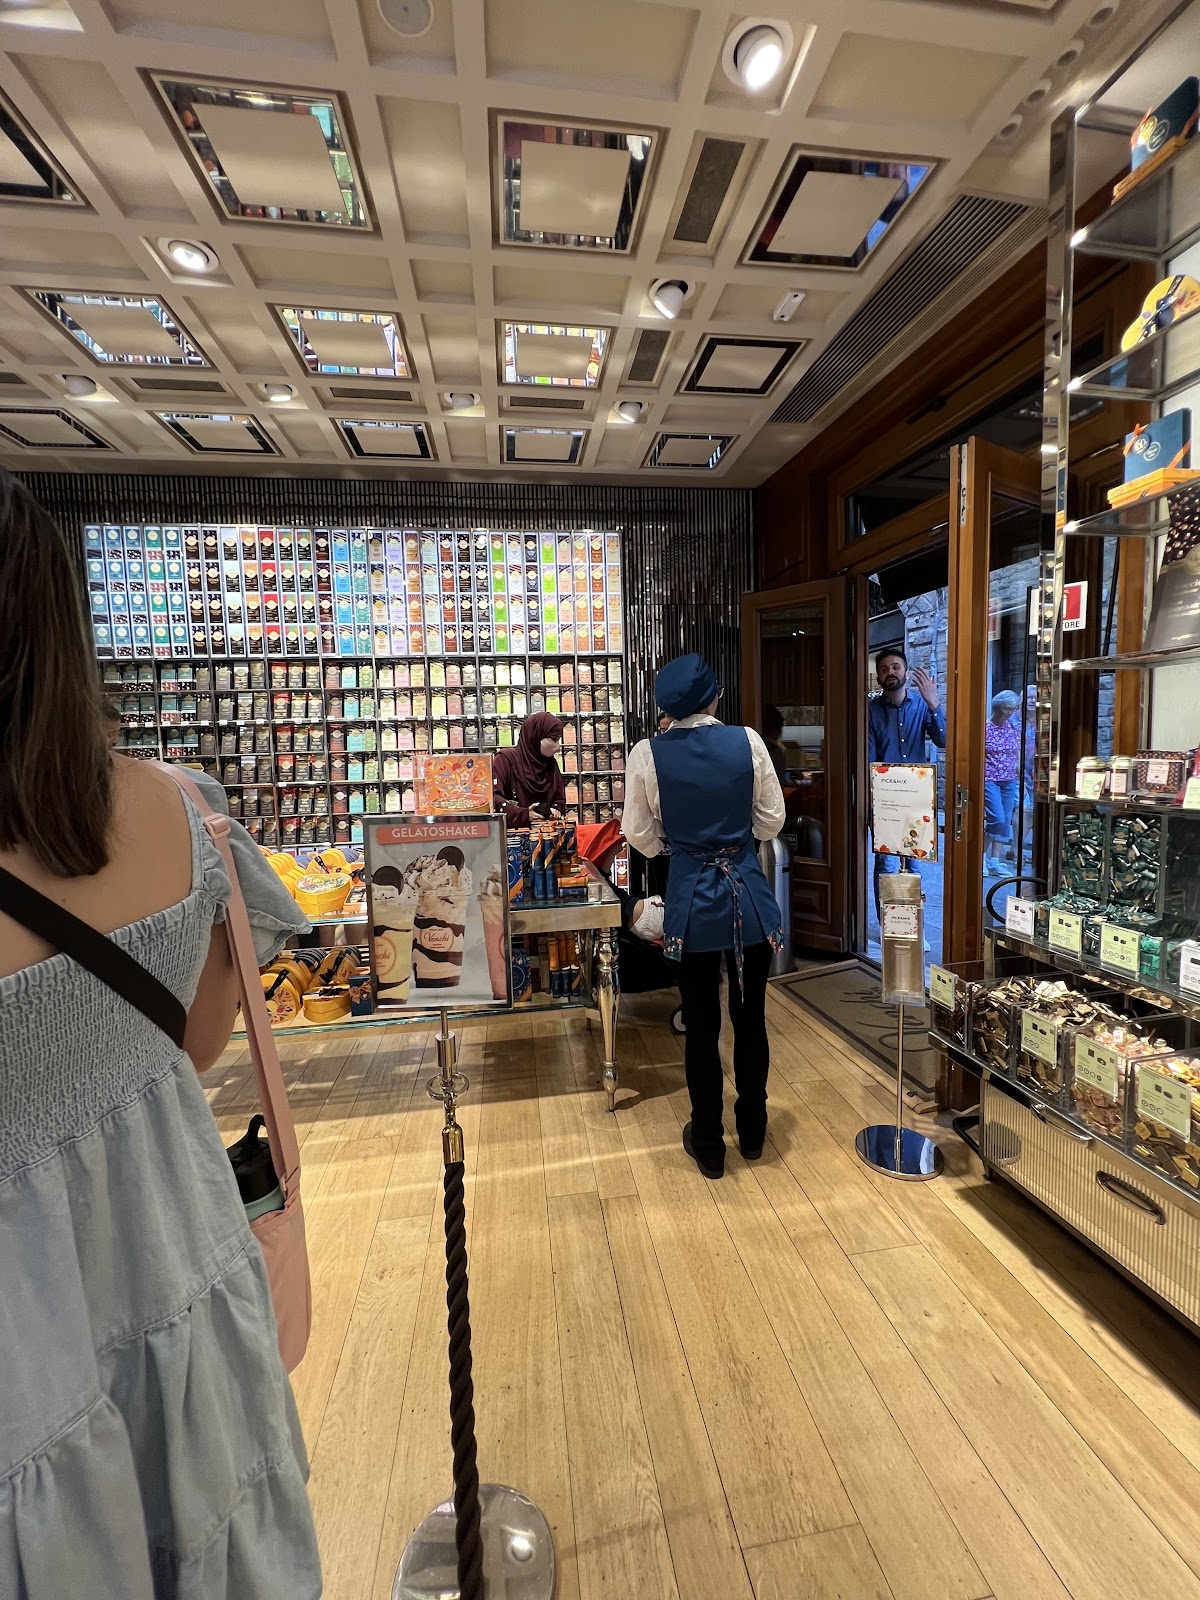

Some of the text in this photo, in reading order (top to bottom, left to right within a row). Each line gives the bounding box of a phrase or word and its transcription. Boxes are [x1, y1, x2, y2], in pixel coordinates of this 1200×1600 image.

[1063, 621, 1080, 629] ORE
[391, 825, 479, 838] GELATOSHAKE
[423, 931, 450, 943] Venchi
